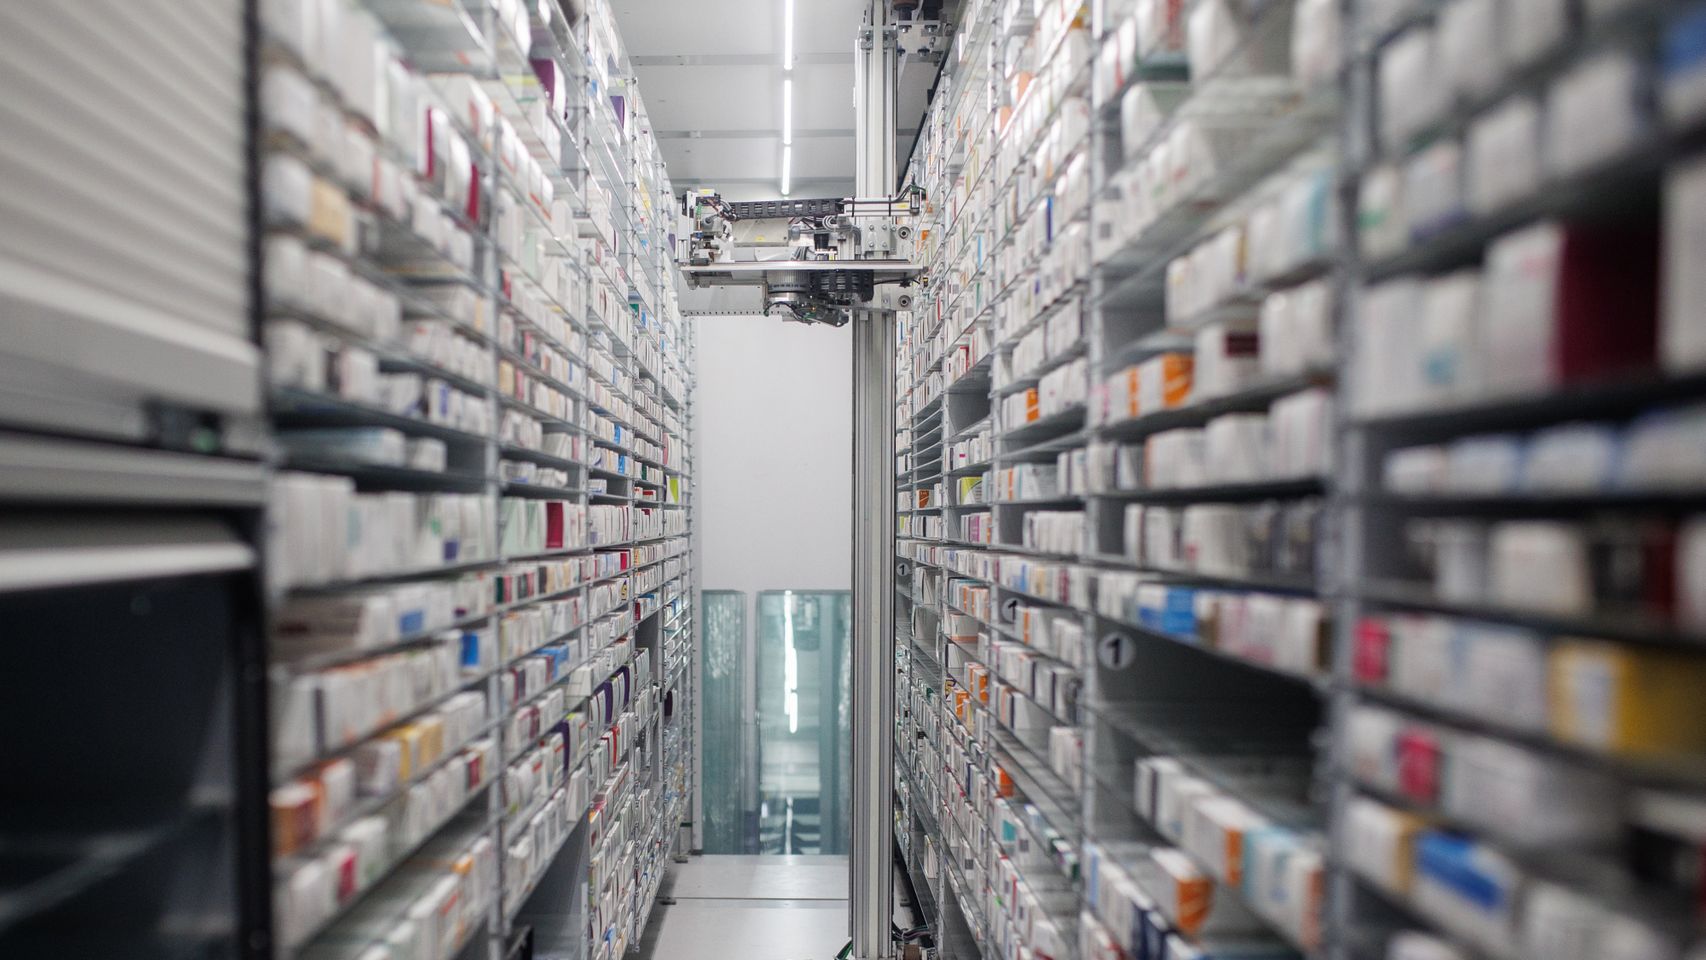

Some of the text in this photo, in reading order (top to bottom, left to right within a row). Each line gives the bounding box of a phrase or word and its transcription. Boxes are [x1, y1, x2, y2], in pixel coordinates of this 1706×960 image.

[899, 564, 905, 575] 1
[1008, 600, 1017, 621] 1
[1105, 637, 1121, 665] 1
